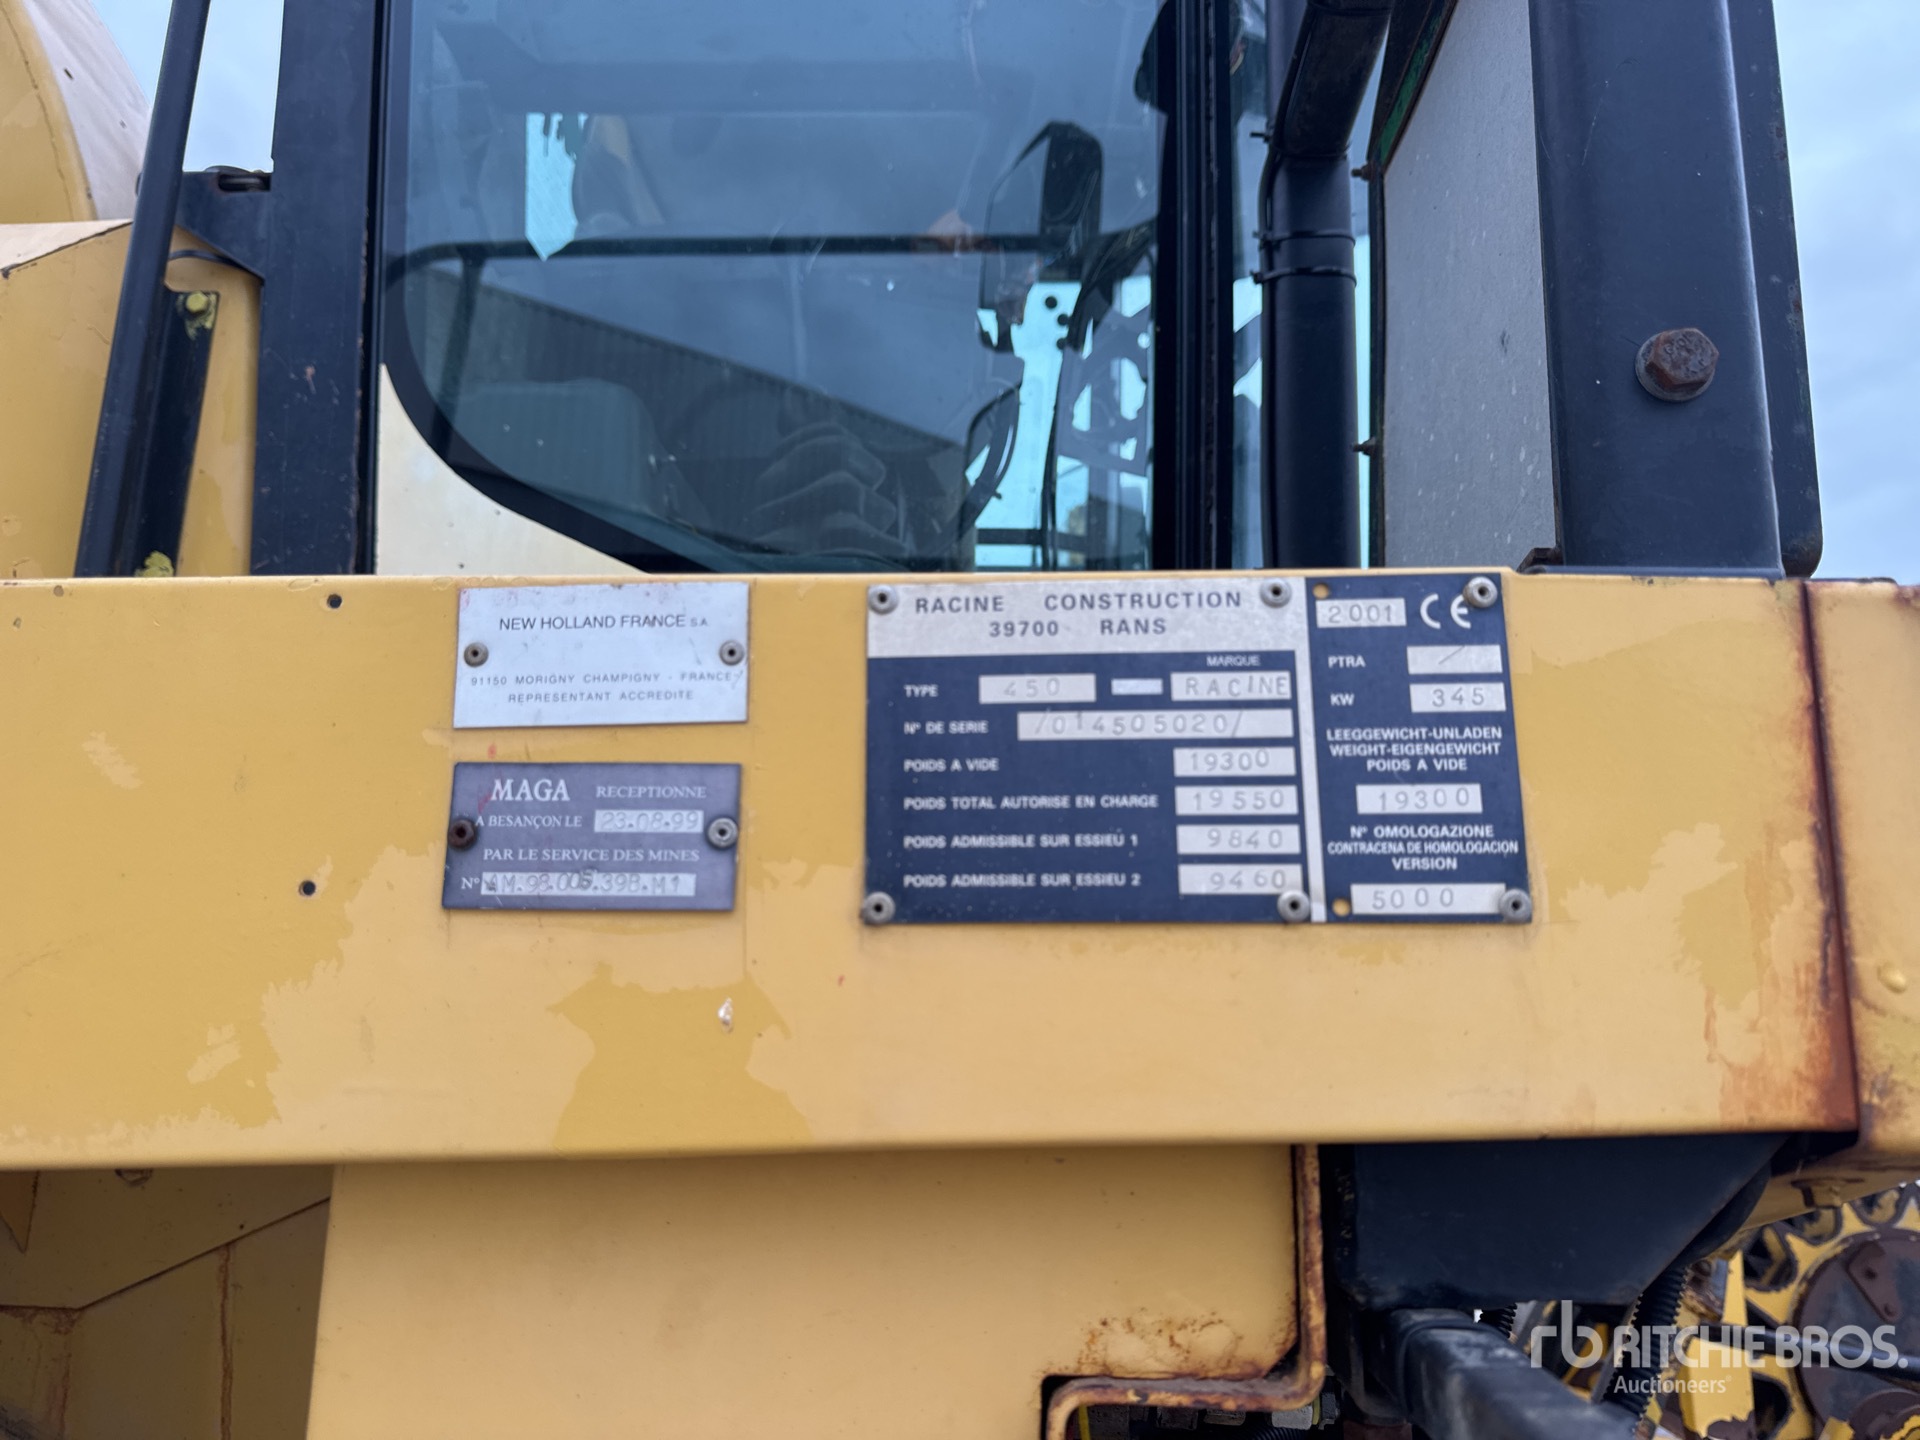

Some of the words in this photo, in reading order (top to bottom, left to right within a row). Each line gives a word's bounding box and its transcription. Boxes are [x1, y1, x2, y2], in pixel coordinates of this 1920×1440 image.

[915, 596, 1005, 614] RACINE
[1044, 591, 1242, 611] CONSTRUCTION
[1328, 604, 1392, 623] 2001
[499, 617, 536, 631] NEW
[540, 616, 616, 629] HOLLAND
[620, 614, 686, 628] FRANCE
[989, 620, 1059, 638] 39700
[1100, 618, 1167, 635] RANS
[1206, 655, 1260, 667] MARQUE
[1328, 655, 1366, 668] PTRA
[471, 676, 507, 686] 91150
[515, 674, 575, 685] MORIGNY
[583, 672, 660, 684] CHAMPIGNY
[680, 671, 732, 682] FRANCE
[1185, 675, 1288, 697] RACINE
[508, 691, 611, 703] REPRESENTANT
[620, 689, 694, 701] ACCREDITE
[904, 684, 938, 698] TYPE
[1003, 677, 1060, 698] 450
[1330, 693, 1354, 706] KW
[1431, 686, 1484, 707] 345
[925, 721, 944, 734] DE
[949, 720, 989, 734] SERIE
[1326, 727, 1502, 741] LEEGGEWICHT-UNLADEN
[1330, 742, 1500, 756] WEIGHT-EIGENGEWICHT
[904, 760, 946, 772] POIDS
[951, 759, 963, 771] A
[967, 759, 1000, 771] VIDE
[1190, 748, 1270, 772] 19300
[1366, 758, 1411, 771] POIDS
[1417, 758, 1428, 770] A
[1433, 758, 1467, 770] VIDE
[491, 779, 570, 801] MAGA
[596, 786, 707, 799] RECEPTIONNE
[904, 798, 946, 810] POIDS
[952, 797, 996, 809] TOTAL
[1001, 796, 1071, 809] AUTORISE
[1075, 796, 1095, 808] EN
[1100, 794, 1159, 808] CHARGE
[1193, 789, 1285, 811] 19550
[1378, 787, 1470, 811] 19300
[475, 816, 485, 826] A
[488, 815, 562, 829] BESANÇON
[565, 816, 582, 827] LE
[602, 811, 699, 831] 23.08.99
[904, 836, 946, 849] POIDS
[951, 835, 1035, 848] ADMISSIBLE
[1040, 835, 1069, 847] SUR
[1075, 834, 1125, 847] ESSIEU
[1131, 834, 1138, 846] 1
[1207, 828, 1283, 849] 9840
[1350, 825, 1368, 838] N°
[1373, 825, 1494, 838] OMOLOGAZIONE
[483, 849, 512, 860] PAR
[518, 849, 537, 860] LE
[542, 849, 609, 861] SERVICE
[614, 849, 643, 861] DES
[648, 849, 700, 862] MINES
[1327, 841, 1404, 855] CONTRACENA
[1406, 841, 1422, 854] DE
[1424, 841, 1519, 854] HOMOLOGACION
[1391, 857, 1457, 870] VERSION
[461, 877, 480, 890] N°
[904, 875, 946, 888] POIDS
[951, 874, 1036, 887] ADMISSIBLE
[1041, 874, 1069, 887] SUR
[1076, 873, 1125, 887] ESSIEU
[1131, 873, 1141, 886] 2
[1210, 870, 1286, 890] 9460
[1372, 888, 1454, 909] 5000
